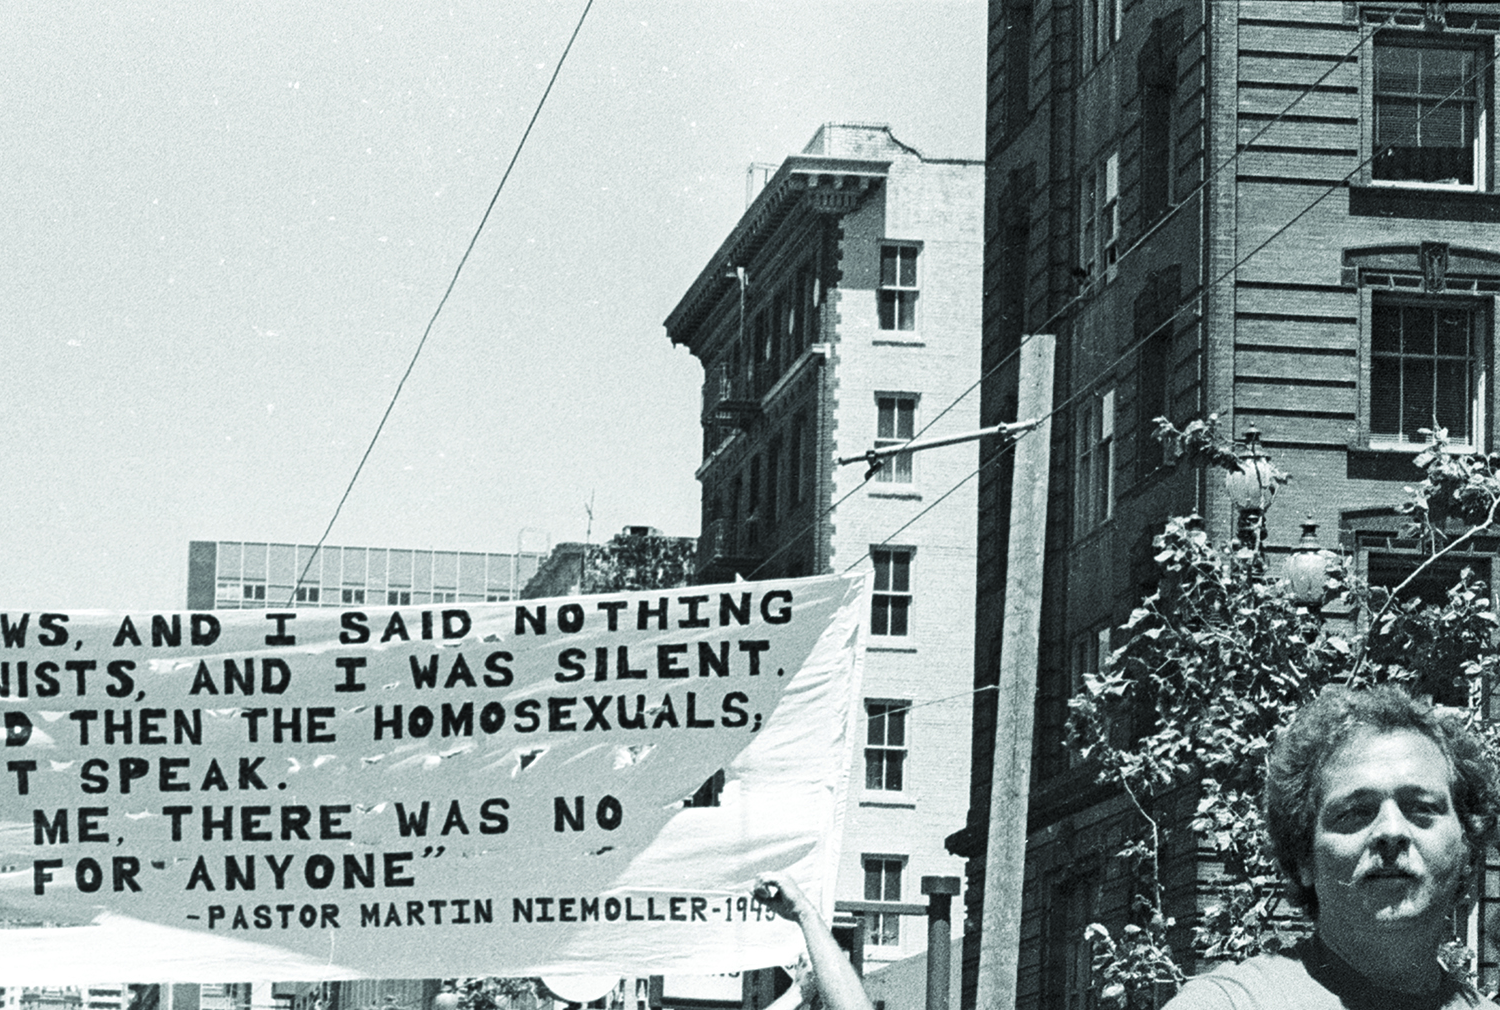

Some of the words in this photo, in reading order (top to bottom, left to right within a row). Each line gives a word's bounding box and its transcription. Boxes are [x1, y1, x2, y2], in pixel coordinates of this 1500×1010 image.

[112, 613, 222, 648] AND
[265, 612, 297, 647] I
[339, 609, 472, 644] SAID
[513, 589, 793, 636] NOTHING
[189, 657, 291, 696] AND
[334, 657, 367, 693] I
[409, 650, 515, 689] WAS
[554, 639, 785, 683] SILENT.
[69, 707, 202, 746] THEN
[241, 706, 336, 744] THE
[373, 690, 764, 741] HOMOSEXUALS;
[79, 756, 288, 795] SPEAK.
[33, 806, 126, 847] ME,
[162, 803, 353, 842] THERE
[394, 798, 511, 837] WAS
[552, 794, 624, 832] NO
[31, 855, 142, 895] FOR
[186, 903, 341, 930] -PASTOR
[360, 899, 494, 927] MARTIN
